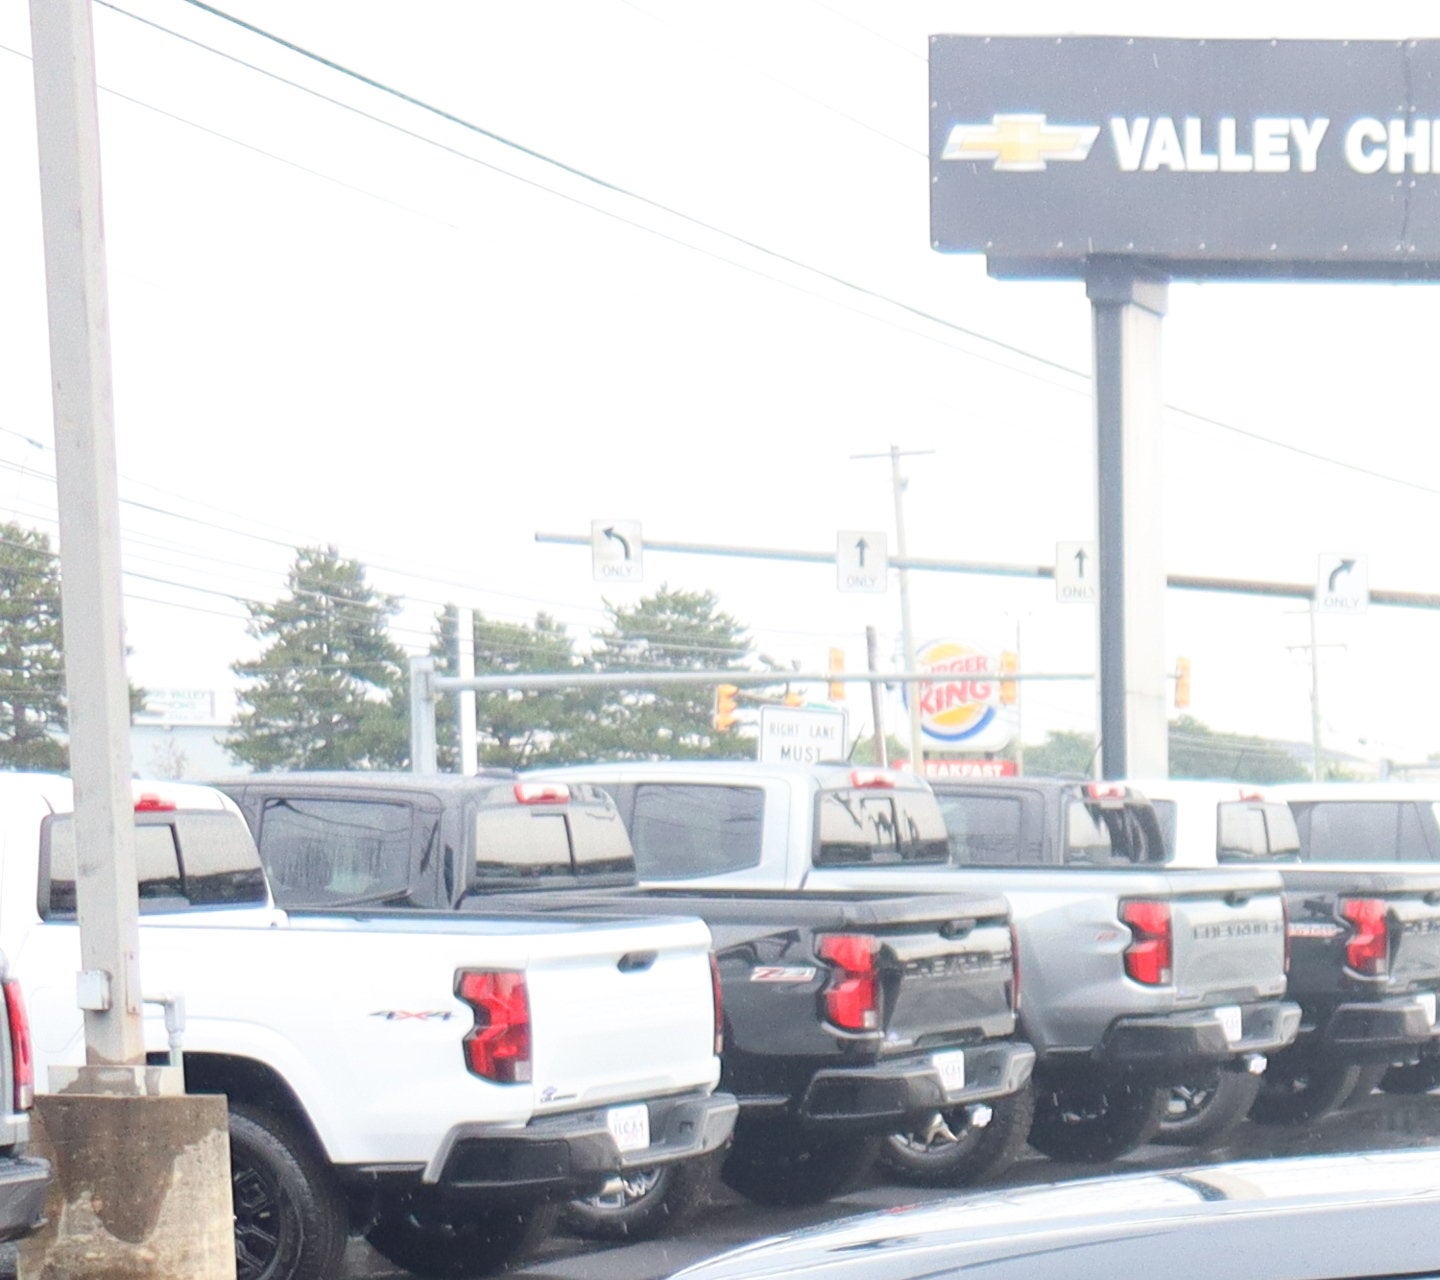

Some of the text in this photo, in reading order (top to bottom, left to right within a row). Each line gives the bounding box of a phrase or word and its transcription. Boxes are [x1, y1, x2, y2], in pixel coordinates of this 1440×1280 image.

[1111, 118, 1329, 174] VALLEY
[602, 565, 633, 578] ONLY
[846, 575, 878, 588] ONLY
[1323, 595, 1361, 610] ONLY
[919, 678, 993, 717] KING
[769, 722, 837, 741] RIGHT LANE
[780, 745, 823, 762] MUST
